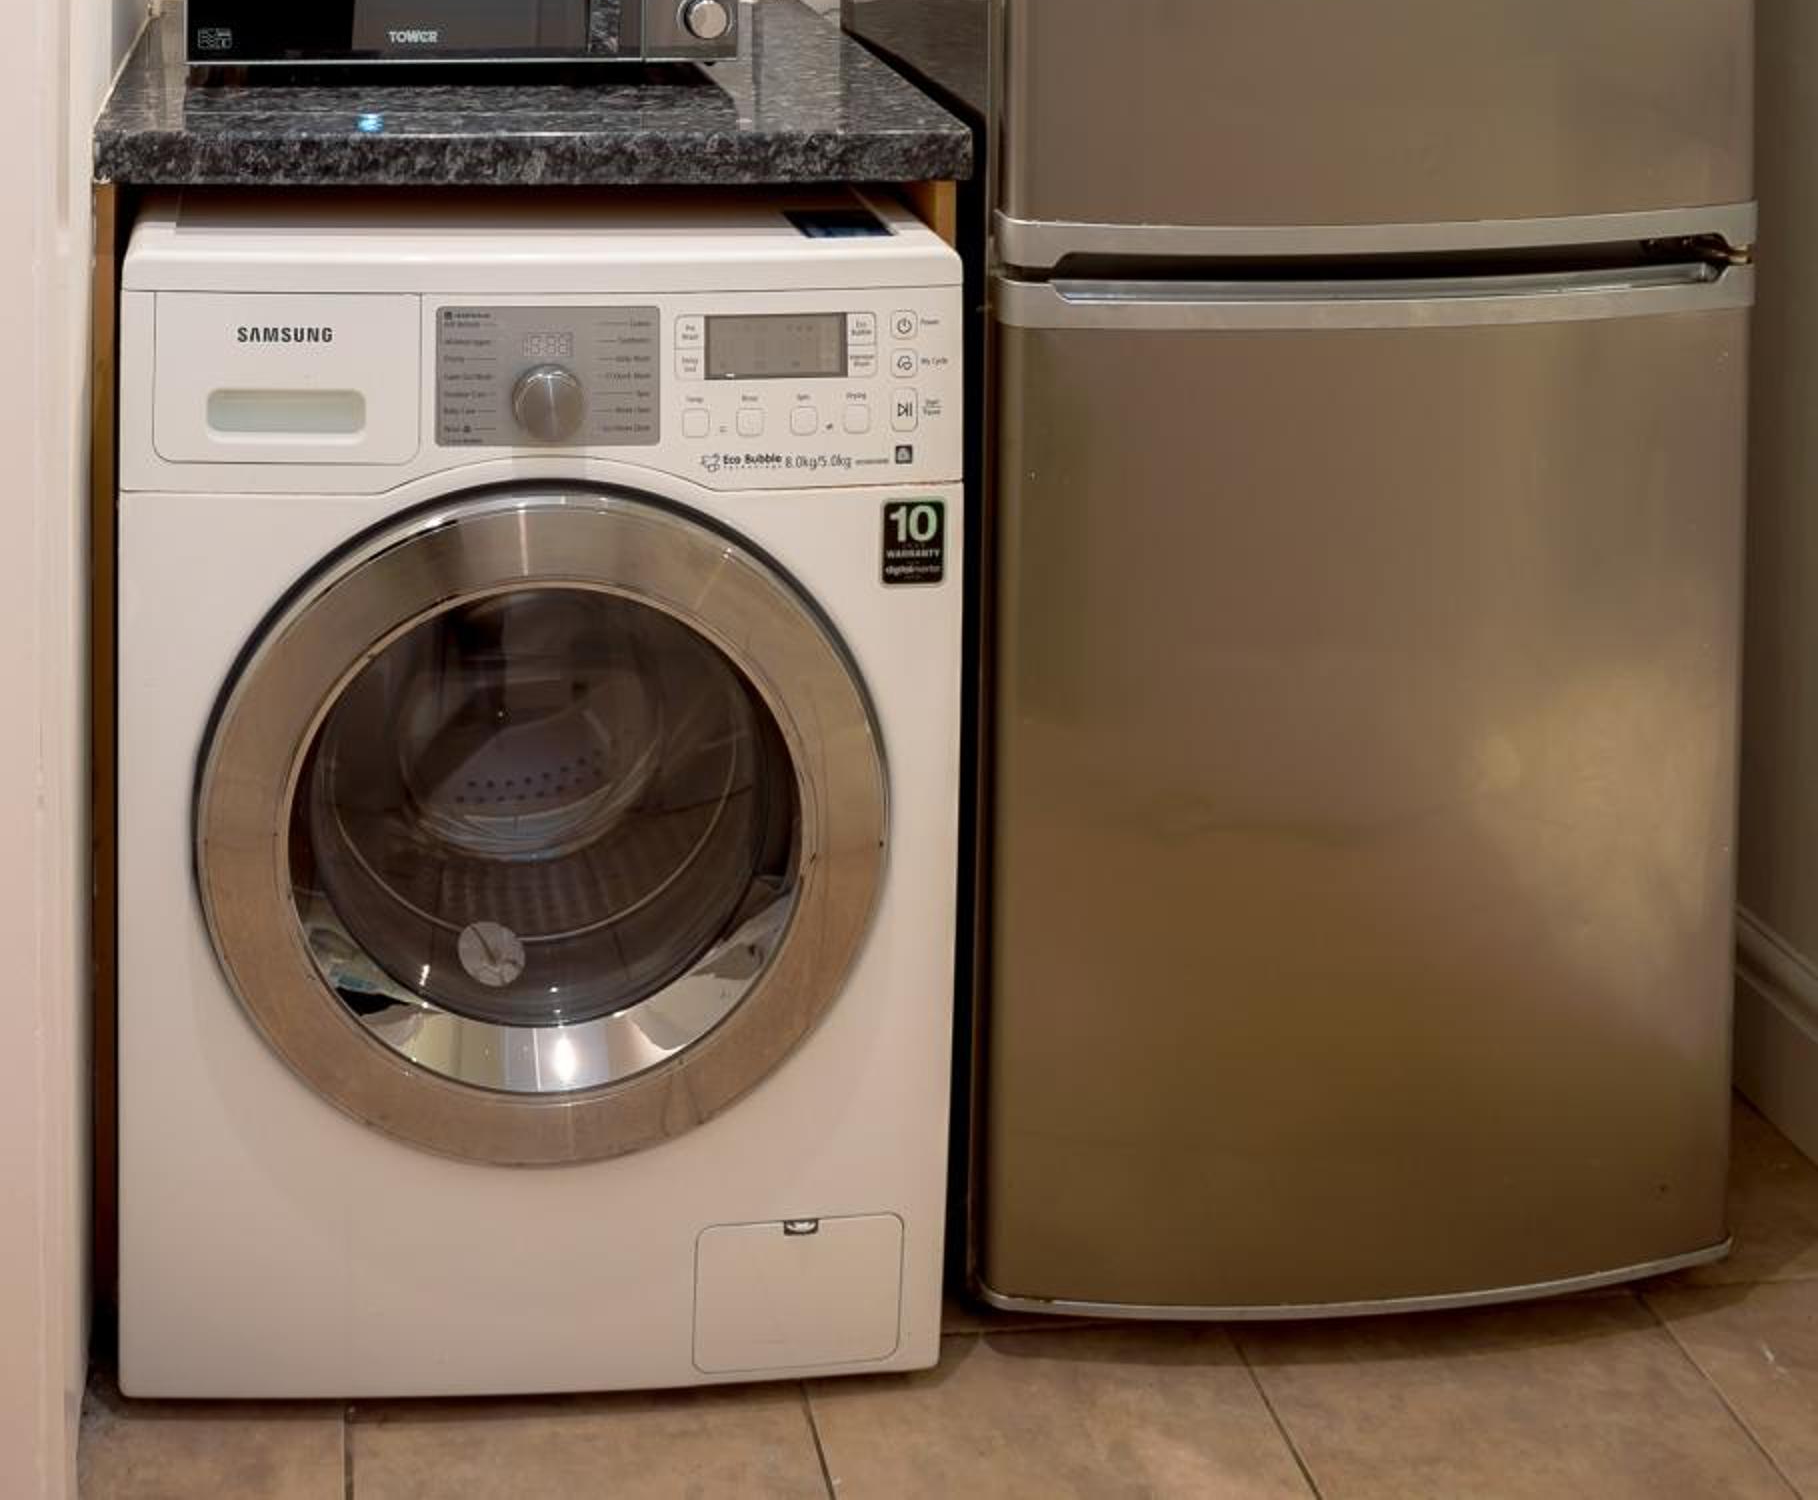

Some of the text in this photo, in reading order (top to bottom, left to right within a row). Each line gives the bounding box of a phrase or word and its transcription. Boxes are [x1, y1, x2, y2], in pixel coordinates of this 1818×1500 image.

[389, 30, 438, 43] TOWER
[237, 326, 333, 343] SAMSUNG
[723, 454, 742, 465] Eco
[744, 453, 783, 465] Bubble
[889, 505, 937, 542] 10
